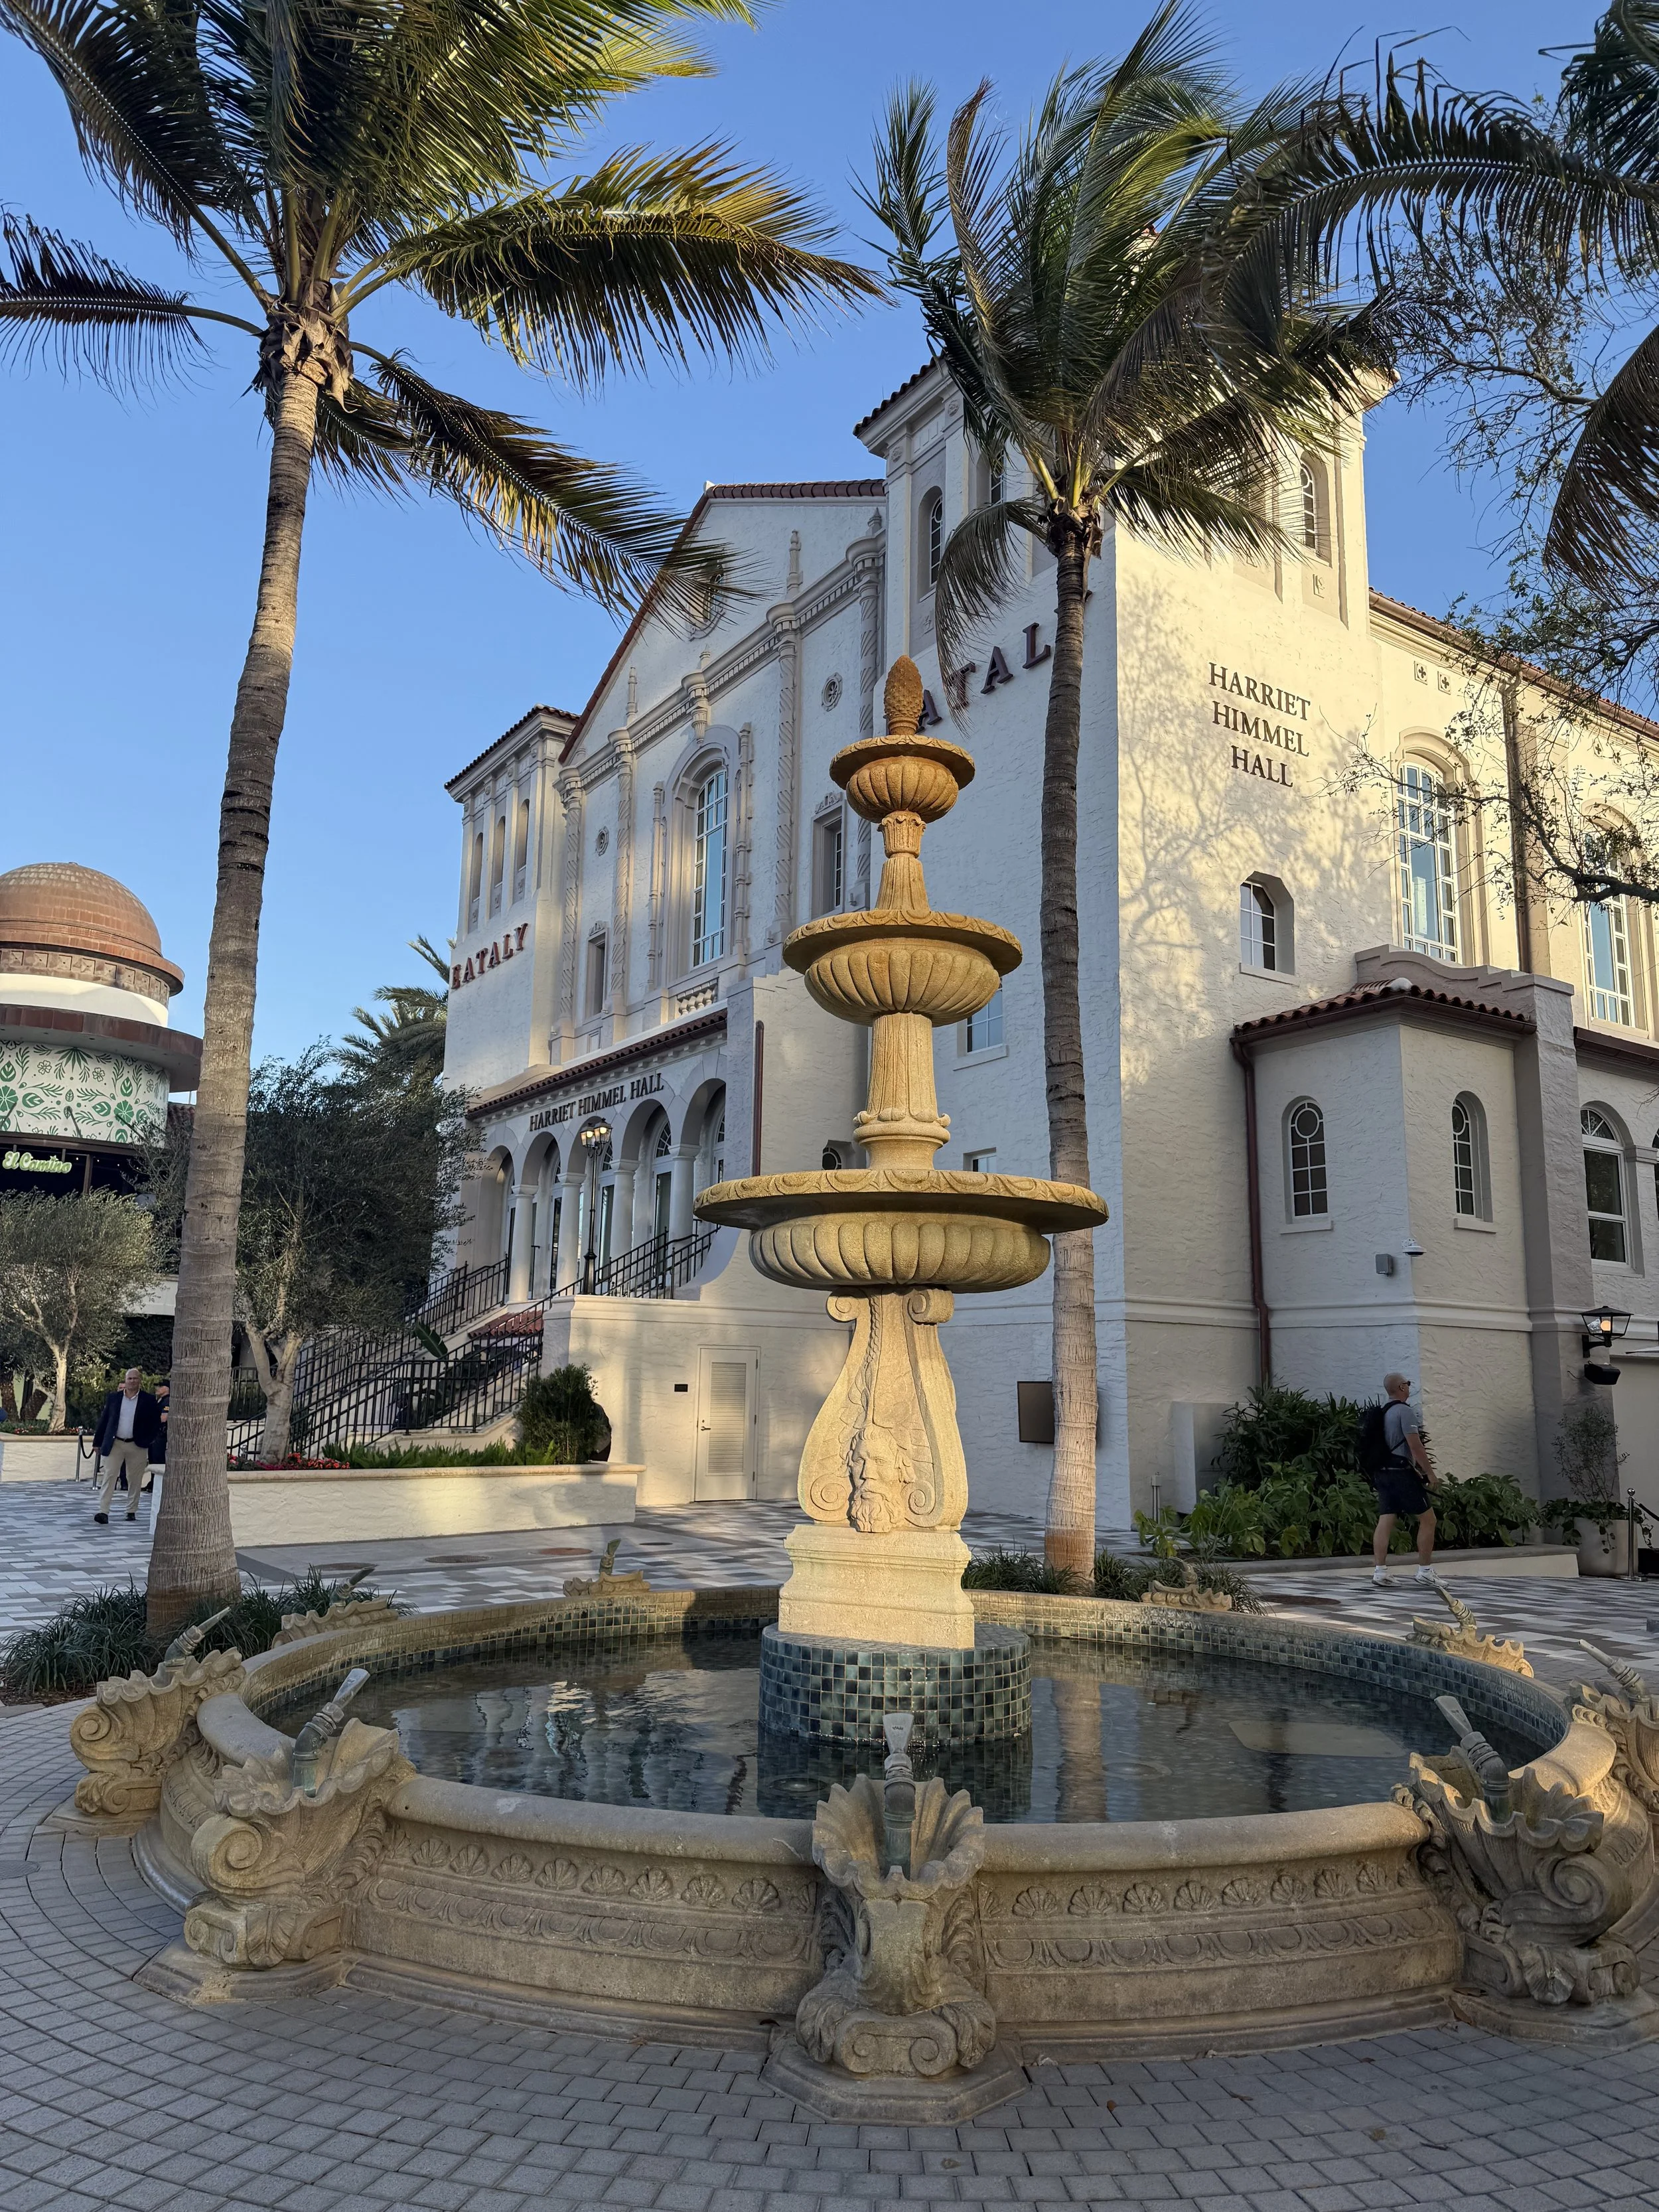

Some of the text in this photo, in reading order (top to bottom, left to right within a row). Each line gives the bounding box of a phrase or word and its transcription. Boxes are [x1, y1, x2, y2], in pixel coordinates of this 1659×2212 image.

[883, 589, 1092, 735] ATAL
[1208, 662, 1311, 721] HARRIET
[1212, 701, 1309, 757] HIMMEL
[1231, 745, 1293, 788] HALL
[451, 922, 528, 990] EATALY
[529, 1072, 664, 1132] HARRIET HIMMEL HALL
[2, 1151, 72, 1173] El Camino
